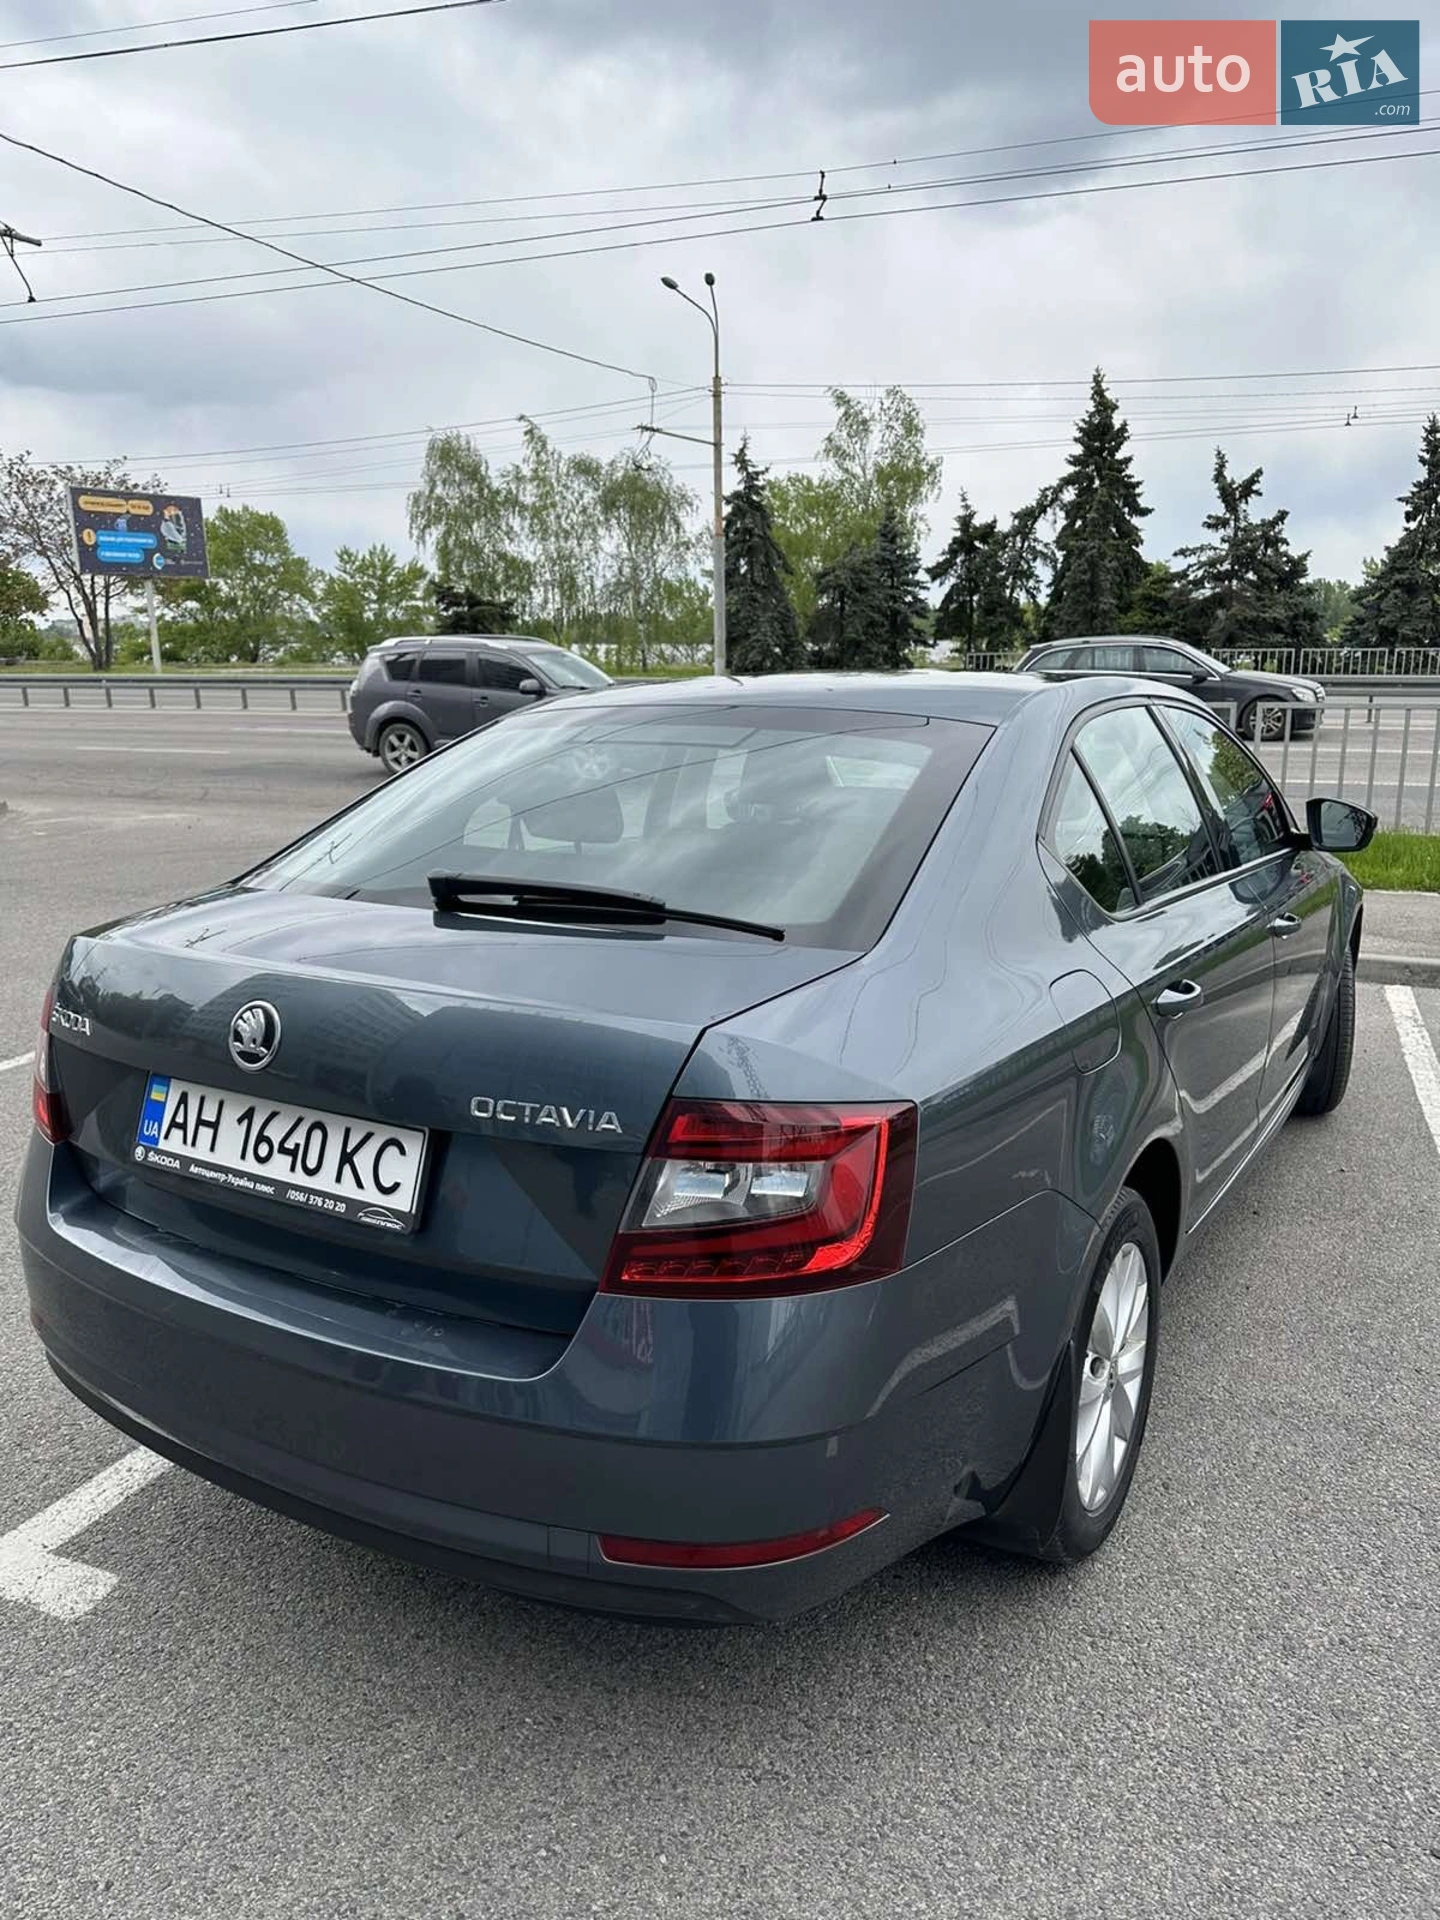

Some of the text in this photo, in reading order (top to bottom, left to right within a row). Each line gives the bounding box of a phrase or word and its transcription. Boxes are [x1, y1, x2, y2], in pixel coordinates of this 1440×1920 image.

[143, 1119, 159, 1138] UA
[470, 1096, 623, 1134] OCTAVIA
[163, 1090, 407, 1196] AH 1640 KC
[308, 1194, 323, 1207] 376
[324, 1198, 334, 1210] 20
[335, 1202, 347, 1213] 20
